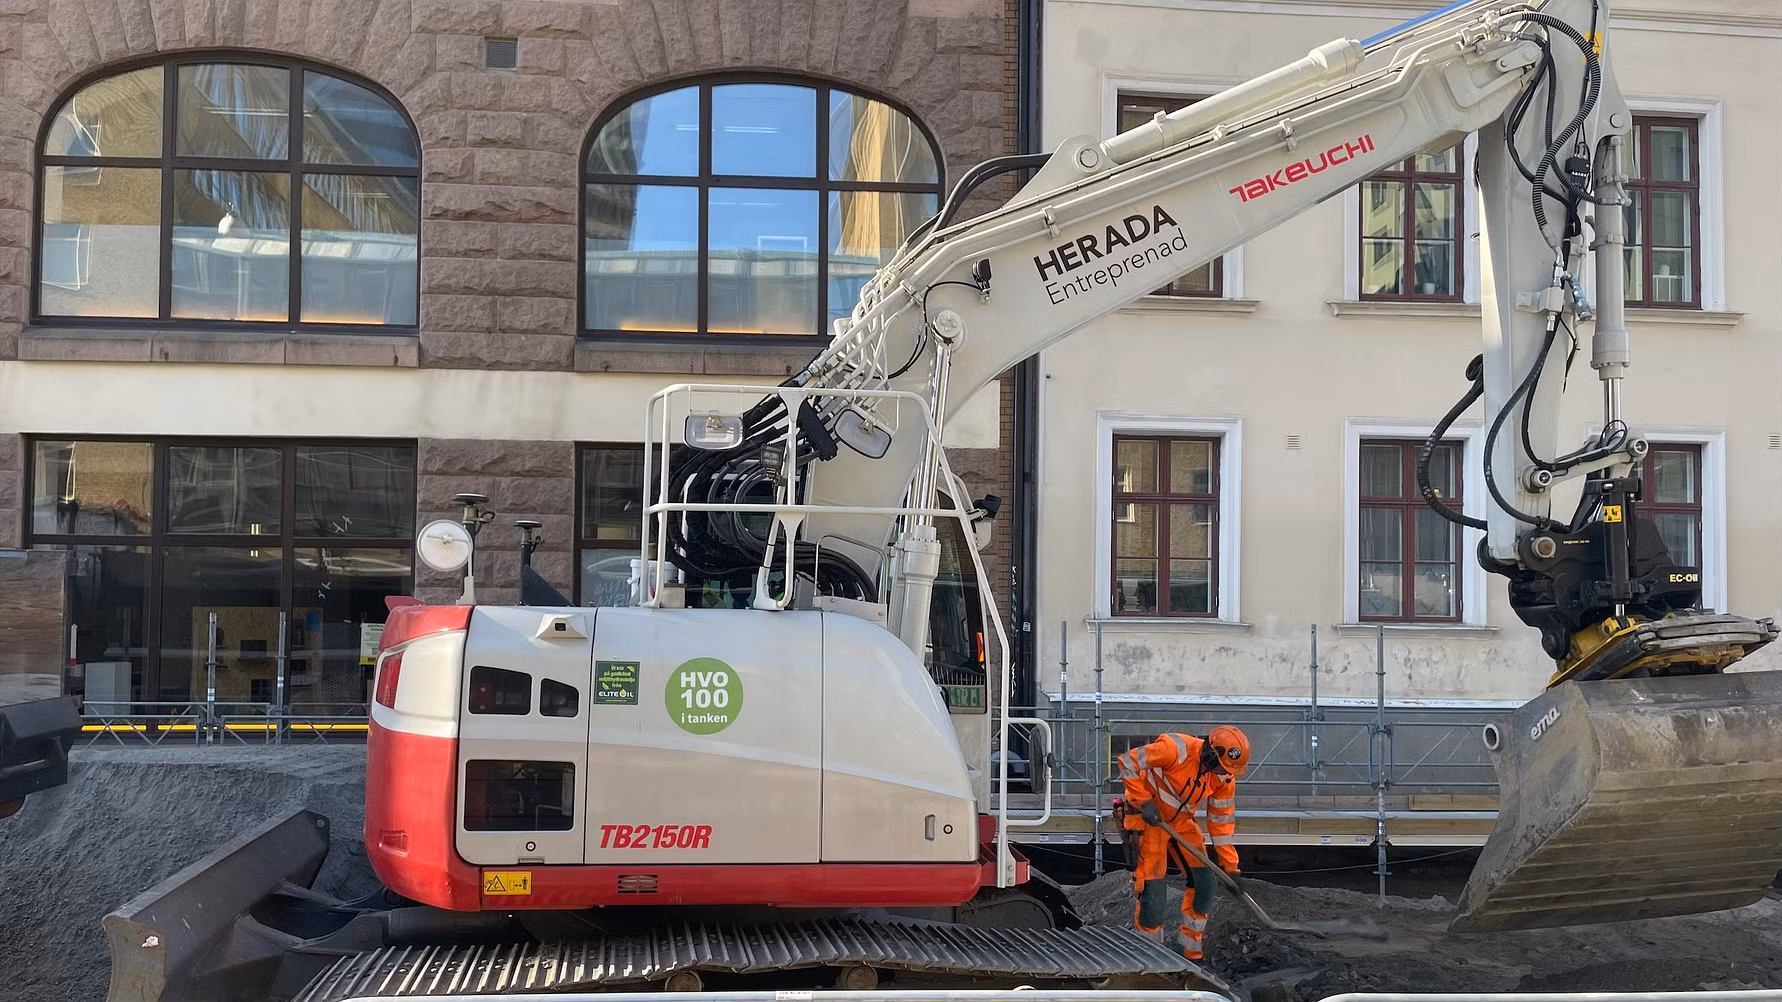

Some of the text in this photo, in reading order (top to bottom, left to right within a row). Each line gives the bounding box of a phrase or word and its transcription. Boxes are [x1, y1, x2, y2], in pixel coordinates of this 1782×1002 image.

[1033, 204, 1178, 282] HERADA
[1045, 227, 1188, 305] Entreprenad
[680, 671, 729, 688] HVO
[680, 688, 729, 708] 100
[681, 712, 728, 724] i tanken
[1530, 706, 1561, 741] ema
[600, 824, 713, 849] TB2150R
